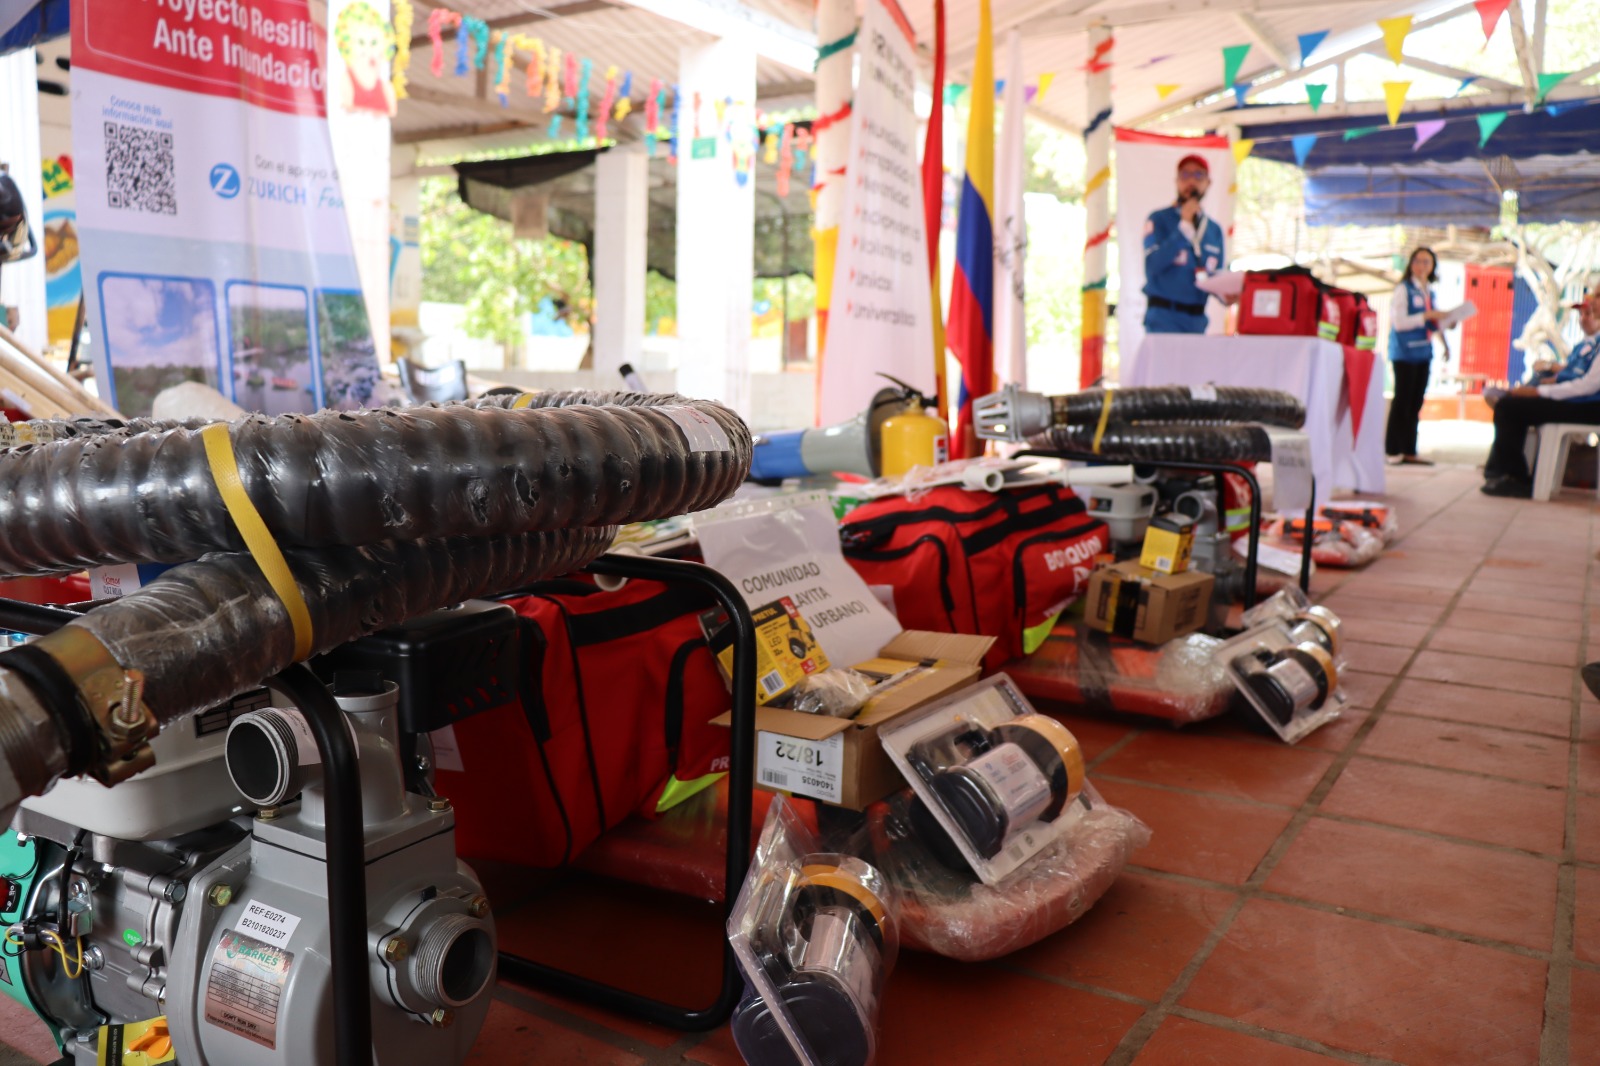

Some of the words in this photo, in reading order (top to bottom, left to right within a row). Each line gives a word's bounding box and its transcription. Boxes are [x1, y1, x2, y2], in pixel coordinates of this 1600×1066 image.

[153, 17, 214, 62] Ante
[247, 176, 307, 206] ZURICH
[742, 561, 820, 594] COMUNIDAD
[795, 586, 831, 609] AYITA
[809, 599, 870, 629] URBANO)
[776, 741, 824, 767] 18/22
[801, 776, 834, 791] 1404035
[249, 904, 286, 924] REF:E0274
[242, 918, 287, 940] B2101820237
[238, 944, 279, 967] BARNES
